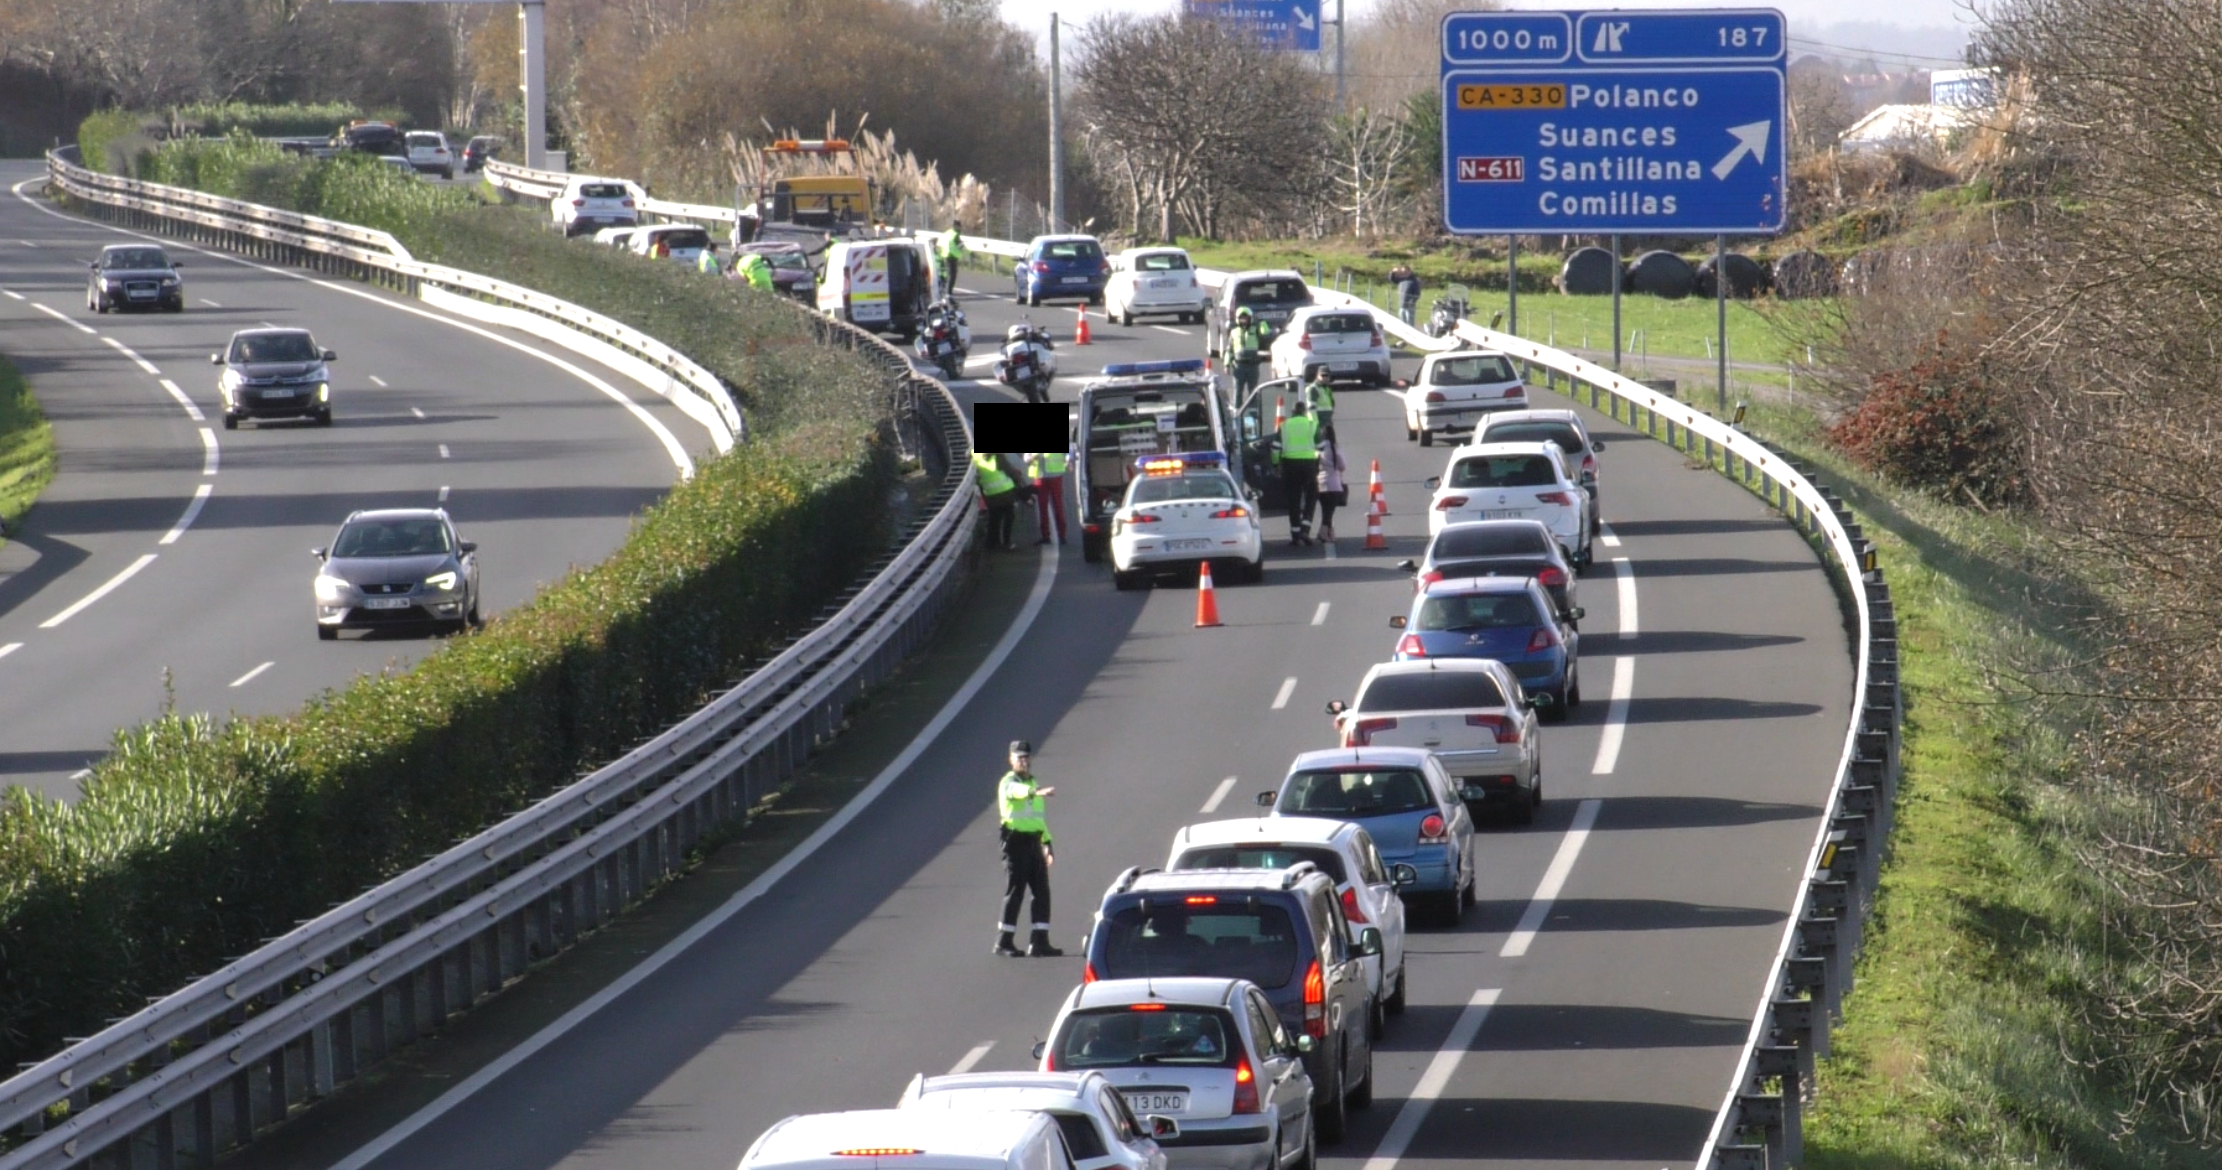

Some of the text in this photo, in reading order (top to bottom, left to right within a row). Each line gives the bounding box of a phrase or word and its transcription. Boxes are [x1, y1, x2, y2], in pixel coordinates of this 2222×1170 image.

[1458, 30, 1557, 50] 1000 m
[1718, 27, 1768, 47] 187
[1461, 86, 1563, 106] CA-330
[1570, 84, 1699, 108] Polanco
[1539, 123, 1677, 147] Suances
[1460, 159, 1522, 180] N-611
[1539, 157, 1702, 181] Santillana
[1539, 192, 1677, 216] Comillas
[1153, 1096, 1181, 1109] DKD
